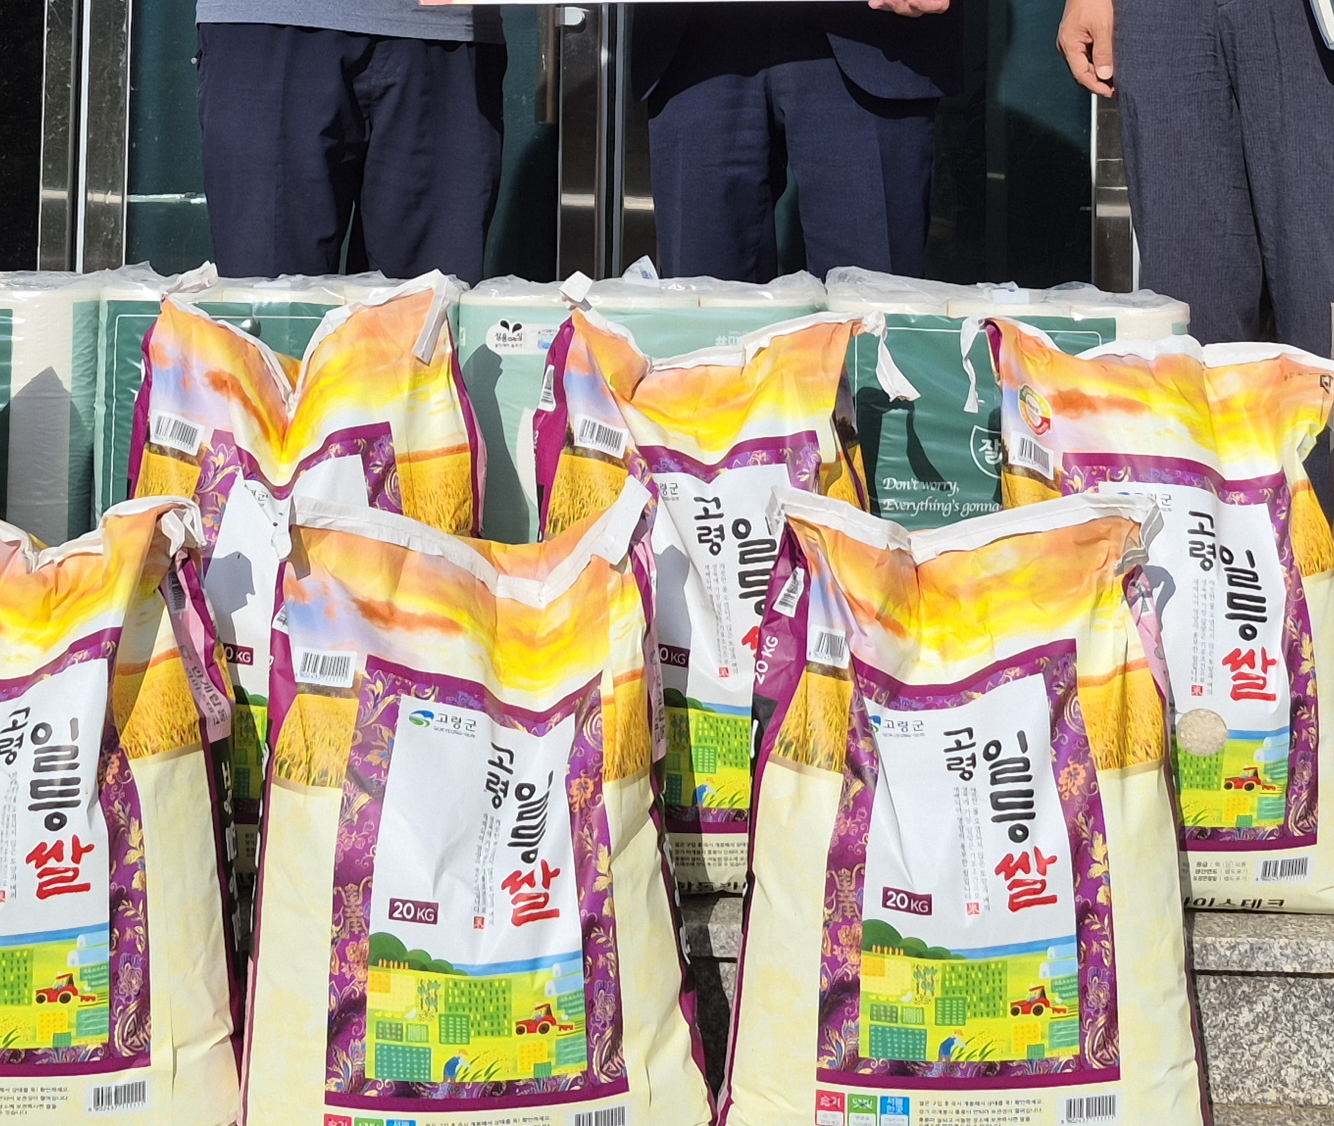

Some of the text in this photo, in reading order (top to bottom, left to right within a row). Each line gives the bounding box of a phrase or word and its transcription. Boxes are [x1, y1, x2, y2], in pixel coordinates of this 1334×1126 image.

[882, 477, 960, 497] Don't worry,
[882, 496, 1000, 517] Everything's gonna
[693, 496, 725, 556] 고령
[1186, 509, 1216, 572] 고령
[225, 647, 251, 664] 0KG
[660, 648, 687, 665] 0KG
[436, 713, 477, 732] 고령군
[882, 718, 924, 732] 고령군
[943, 727, 977, 782] 고령
[484, 742, 515, 809] 고령
[1184, 896, 1285, 909] 이스테크
